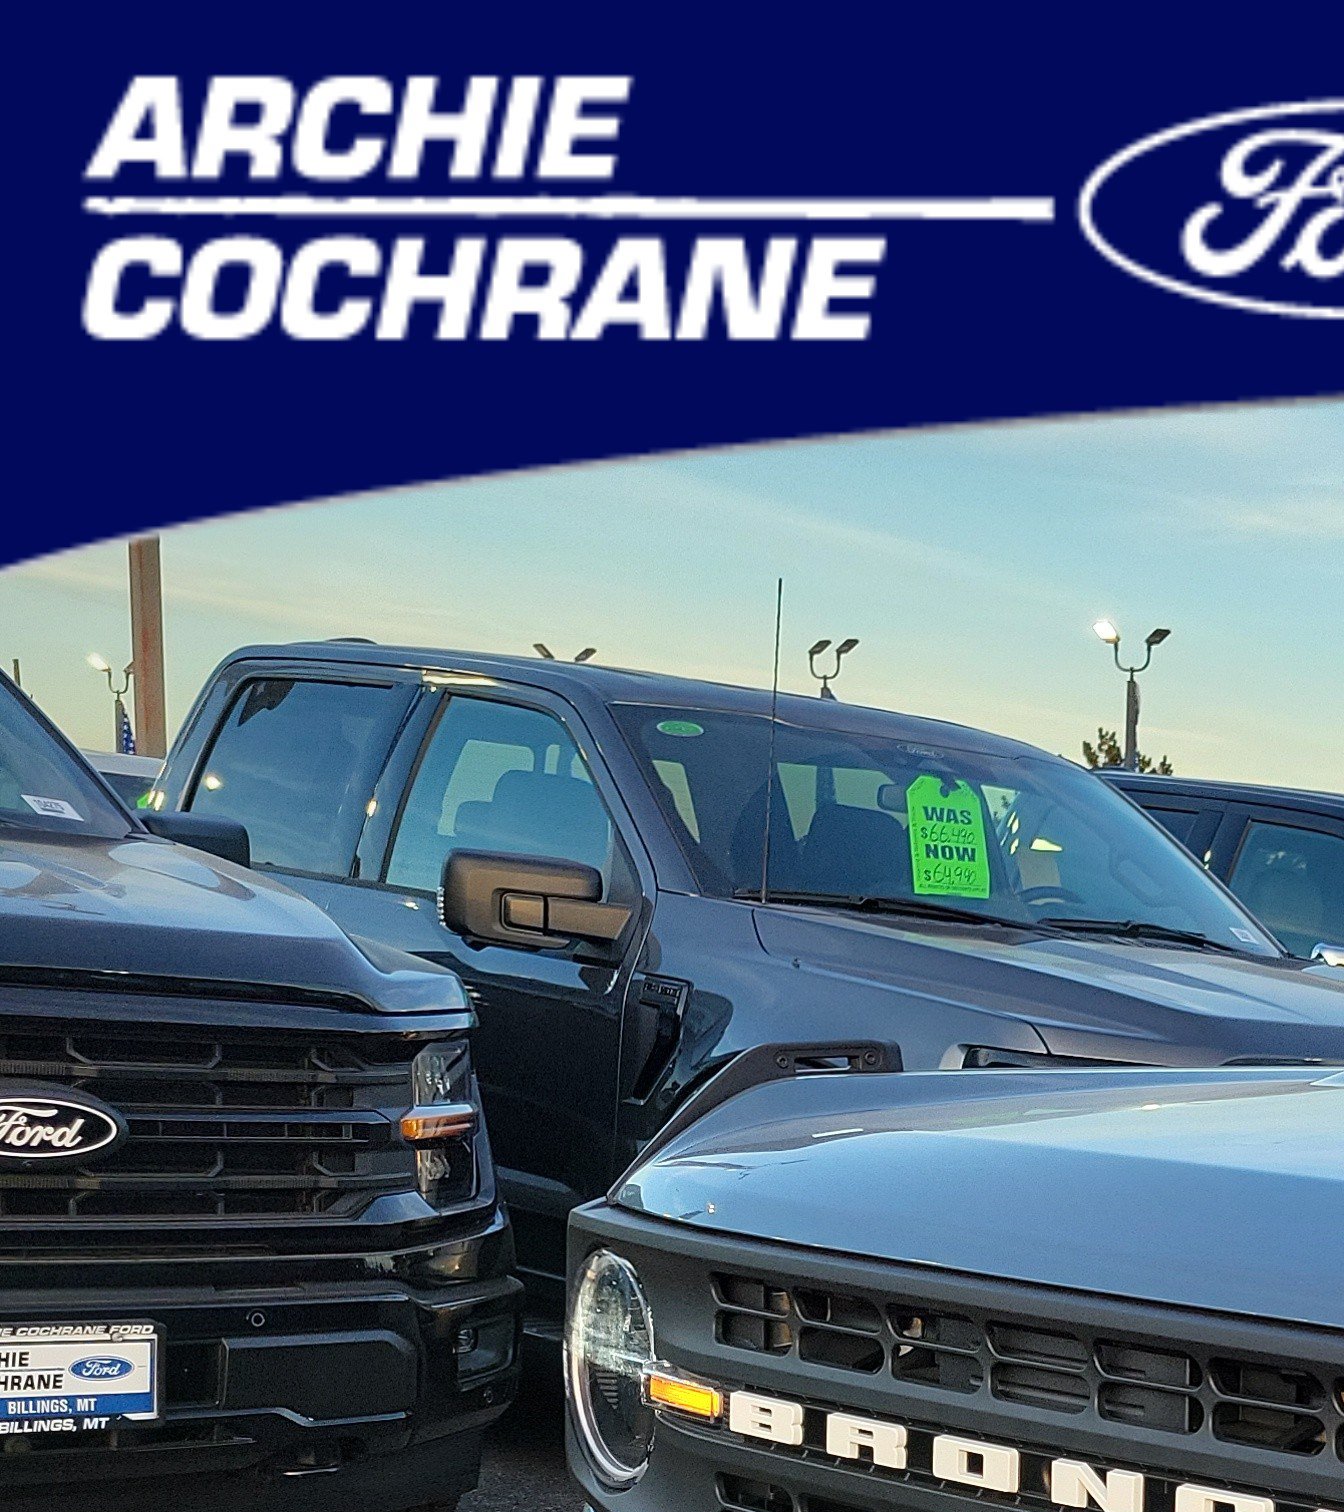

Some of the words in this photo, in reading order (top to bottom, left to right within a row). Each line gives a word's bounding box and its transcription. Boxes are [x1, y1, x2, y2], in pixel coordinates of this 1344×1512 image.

[923, 806, 972, 825] WAS
[925, 844, 976, 862] NOW
[16, 1325, 106, 1336] COCHRANE
[109, 1325, 154, 1335] FORD
[82, 1359, 121, 1377] Ford
[8, 1399, 73, 1415] BILLINGS,
[77, 1398, 97, 1412] MT
[0, 1419, 77, 1435] BILLINGS,
[83, 1417, 110, 1430] MT
